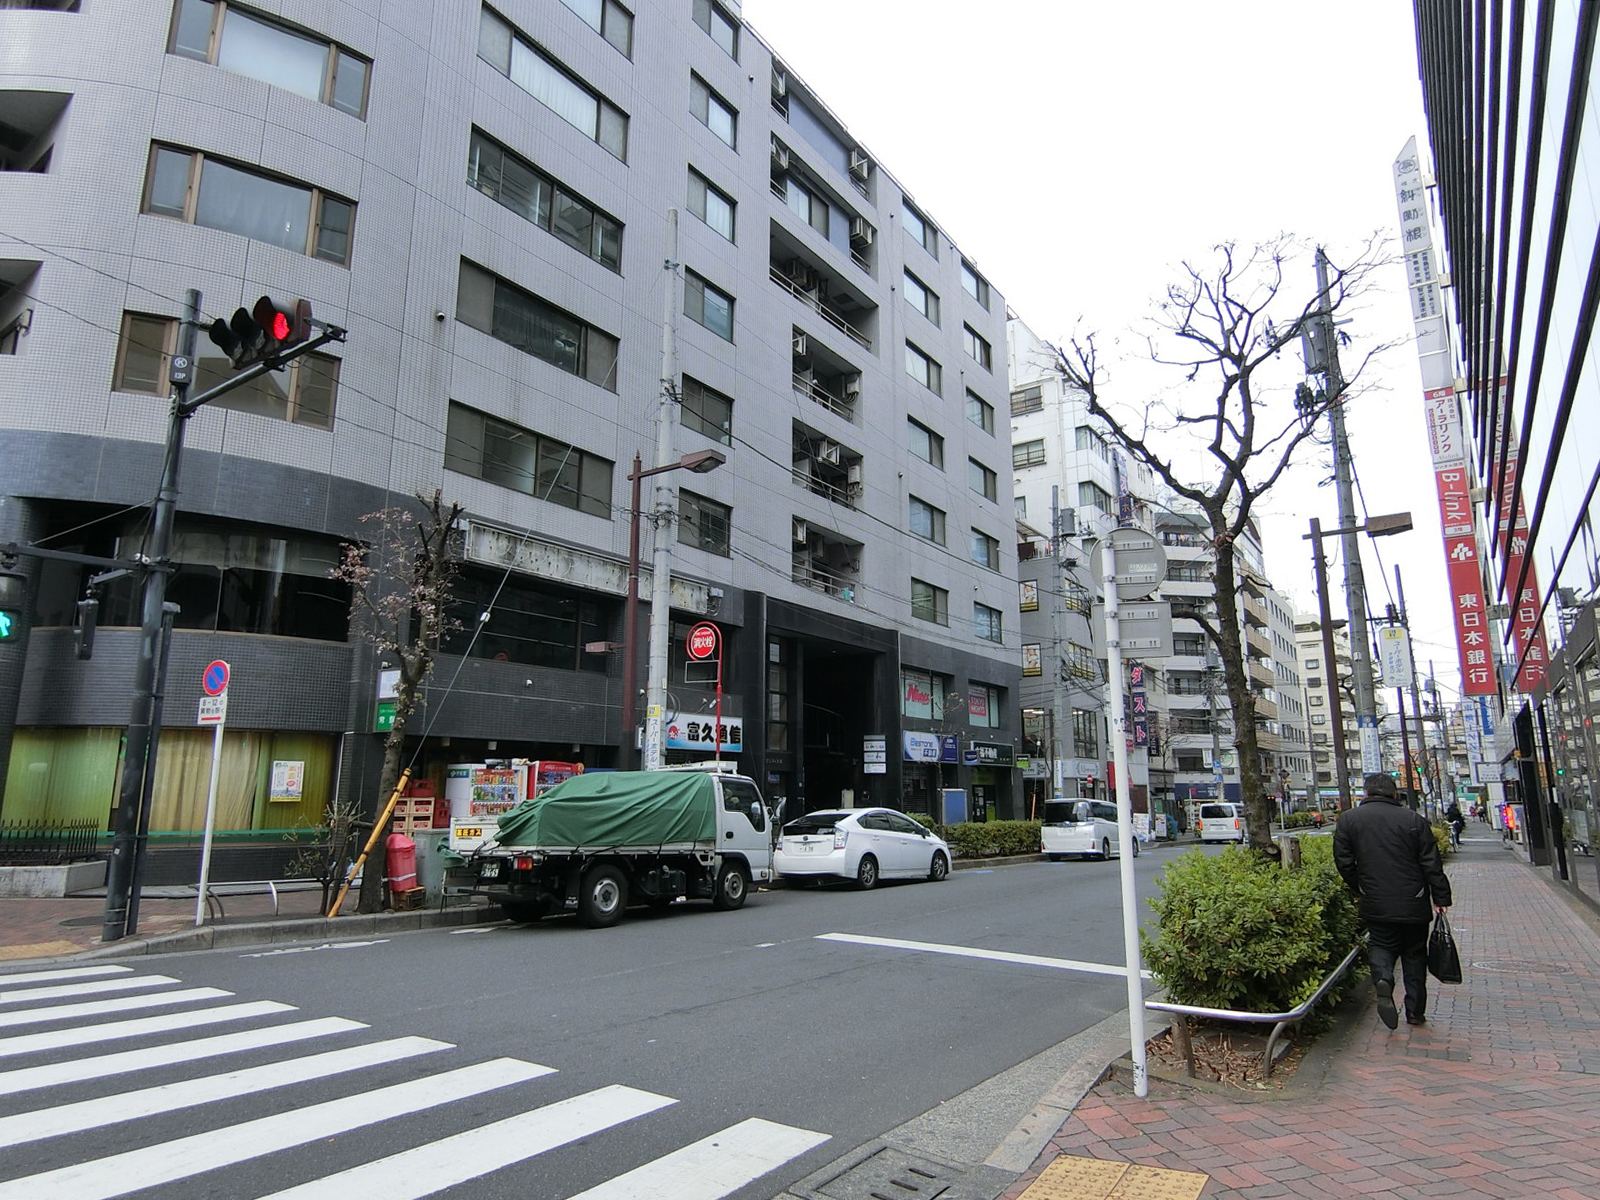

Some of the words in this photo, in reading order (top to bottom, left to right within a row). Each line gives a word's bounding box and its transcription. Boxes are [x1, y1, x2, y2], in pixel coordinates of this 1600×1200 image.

[1435, 399, 1451, 453] アーラリンク
[1441, 472, 1467, 520] B-link
[693, 636, 713, 649] 消火栓
[1458, 593, 1489, 684] 東日本銀行
[650, 718, 659, 763] スーパーホテル
[687, 721, 741, 744] 富久通信
[455, 828, 482, 837] 高圧ガス
